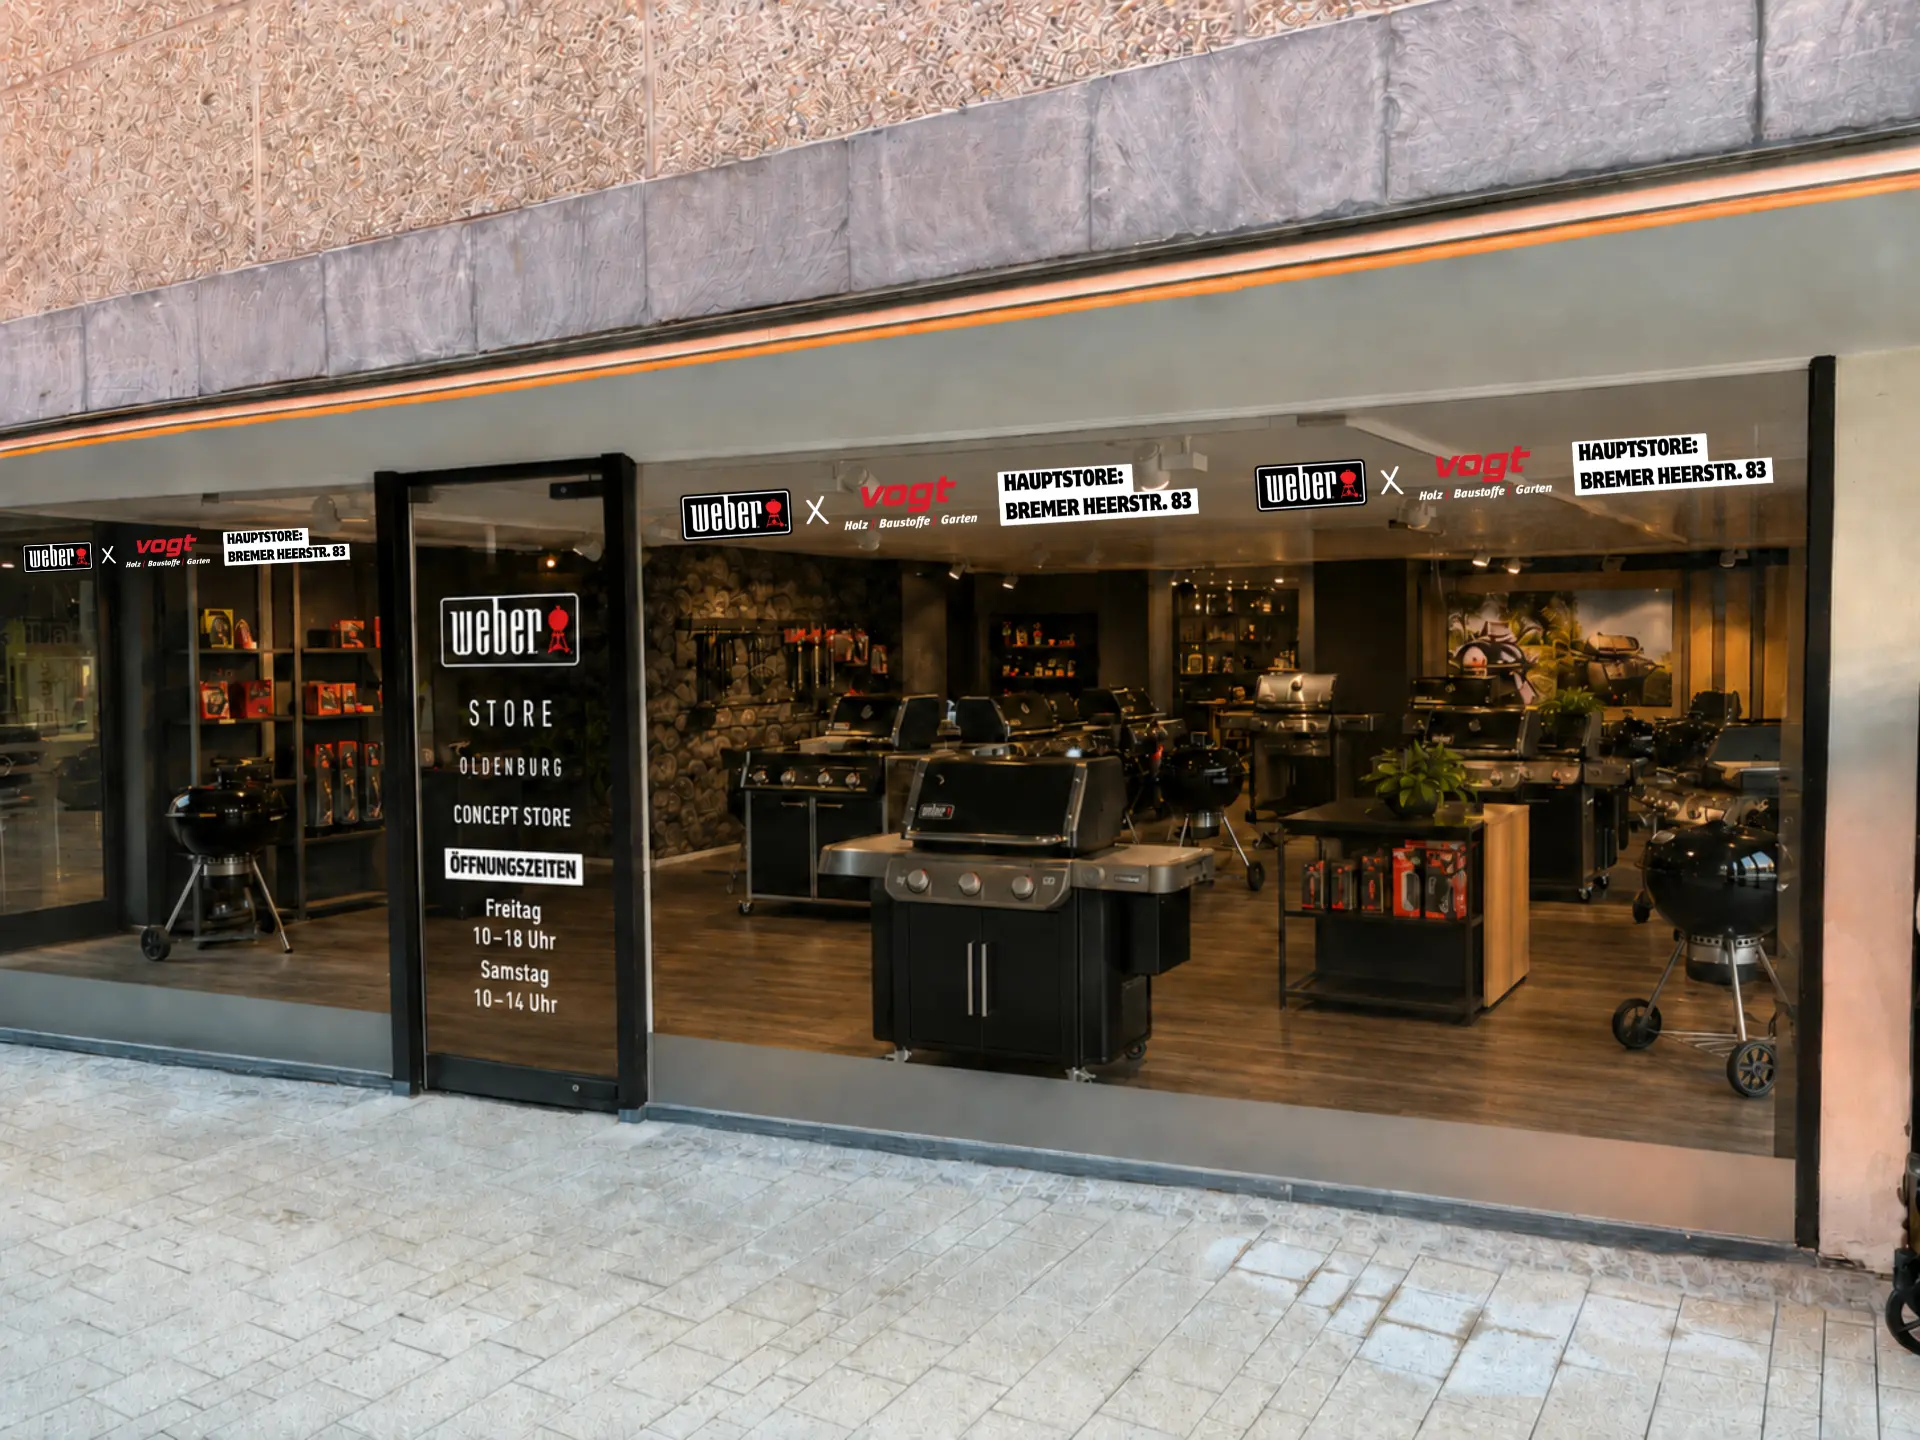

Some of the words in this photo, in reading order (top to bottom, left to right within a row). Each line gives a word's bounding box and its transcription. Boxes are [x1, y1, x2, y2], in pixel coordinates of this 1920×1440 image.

[1578, 437, 1698, 461] HAUPTSTORE:
[1435, 446, 1531, 483] vogt
[1580, 467, 1654, 490] BREMER
[1658, 462, 1742, 485] HEERSTR.
[1745, 461, 1766, 479] 83
[1004, 467, 1124, 491] HAUPTSTORE:
[1265, 466, 1337, 503] weber
[860, 475, 957, 513] vogt
[1419, 489, 1443, 501] Holz
[1454, 486, 1505, 500] Baustoffe
[1515, 482, 1553, 495] Garten
[690, 495, 762, 532] weber
[1005, 498, 1080, 520] BREMER
[1083, 493, 1168, 515] HEERSTR.
[1171, 491, 1192, 510] 83
[844, 519, 869, 531] Holz
[879, 516, 931, 530] Baustoffe
[941, 513, 978, 526] Garten
[136, 534, 197, 557] vogt
[227, 530, 303, 544] HAUPTSTORE:
[28, 544, 75, 568] weber
[125, 561, 142, 569] Holz
[147, 559, 181, 568] Baustoffe
[186, 558, 211, 566] Garten
[228, 549, 275, 562] BREMER
[276, 547, 331, 560] HEERSTR.
[332, 545, 346, 557] 83
[450, 598, 543, 656] weber
[469, 699, 553, 727] STORE
[459, 756, 562, 777] OLDENBURG
[453, 804, 519, 825] CONCEPT
[523, 806, 571, 827] STORE
[450, 851, 576, 879] ÖFFNUNGSZEITEN
[485, 898, 542, 925] Freitag
[528, 930, 557, 950] Uhr
[480, 959, 549, 988] Samstag
[529, 992, 558, 1014] Uhr
